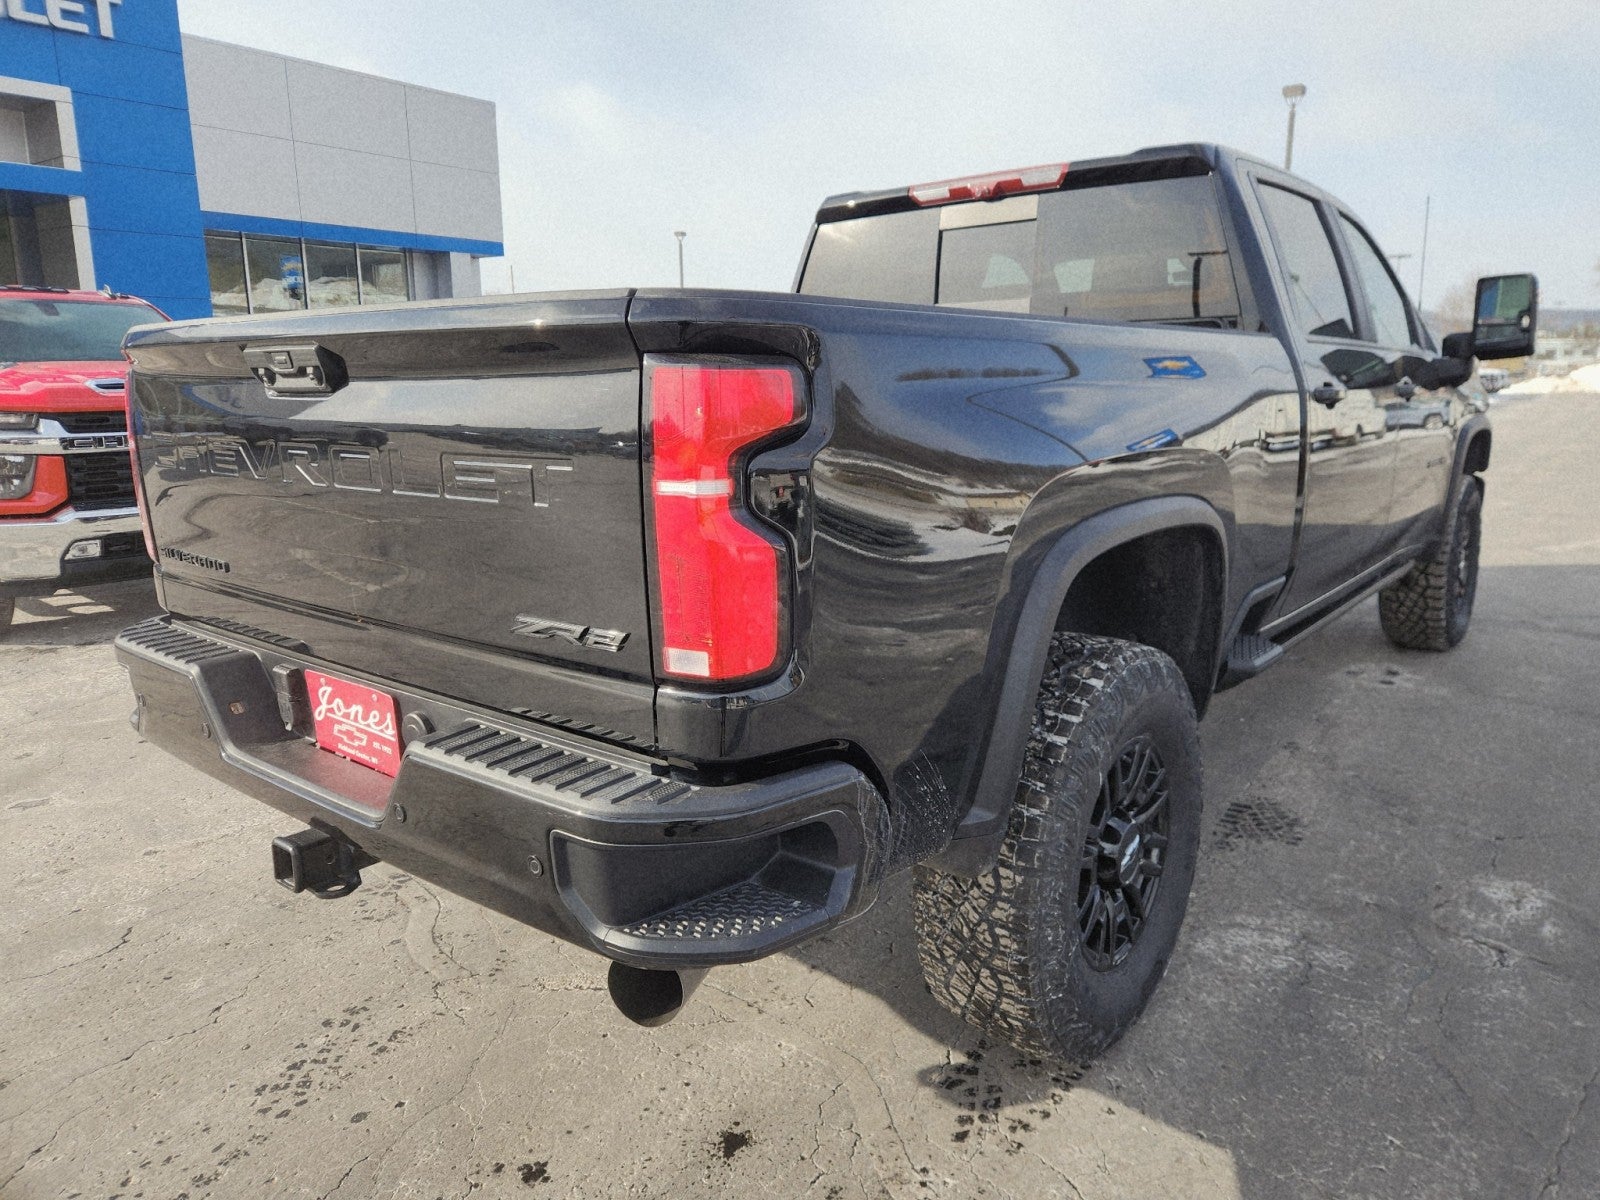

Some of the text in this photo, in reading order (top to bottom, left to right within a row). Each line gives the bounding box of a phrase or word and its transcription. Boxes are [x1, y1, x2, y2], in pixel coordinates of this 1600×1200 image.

[0, 0, 121, 38] LET
[509, 613, 632, 653] ZR2
[314, 686, 396, 735] Jones
